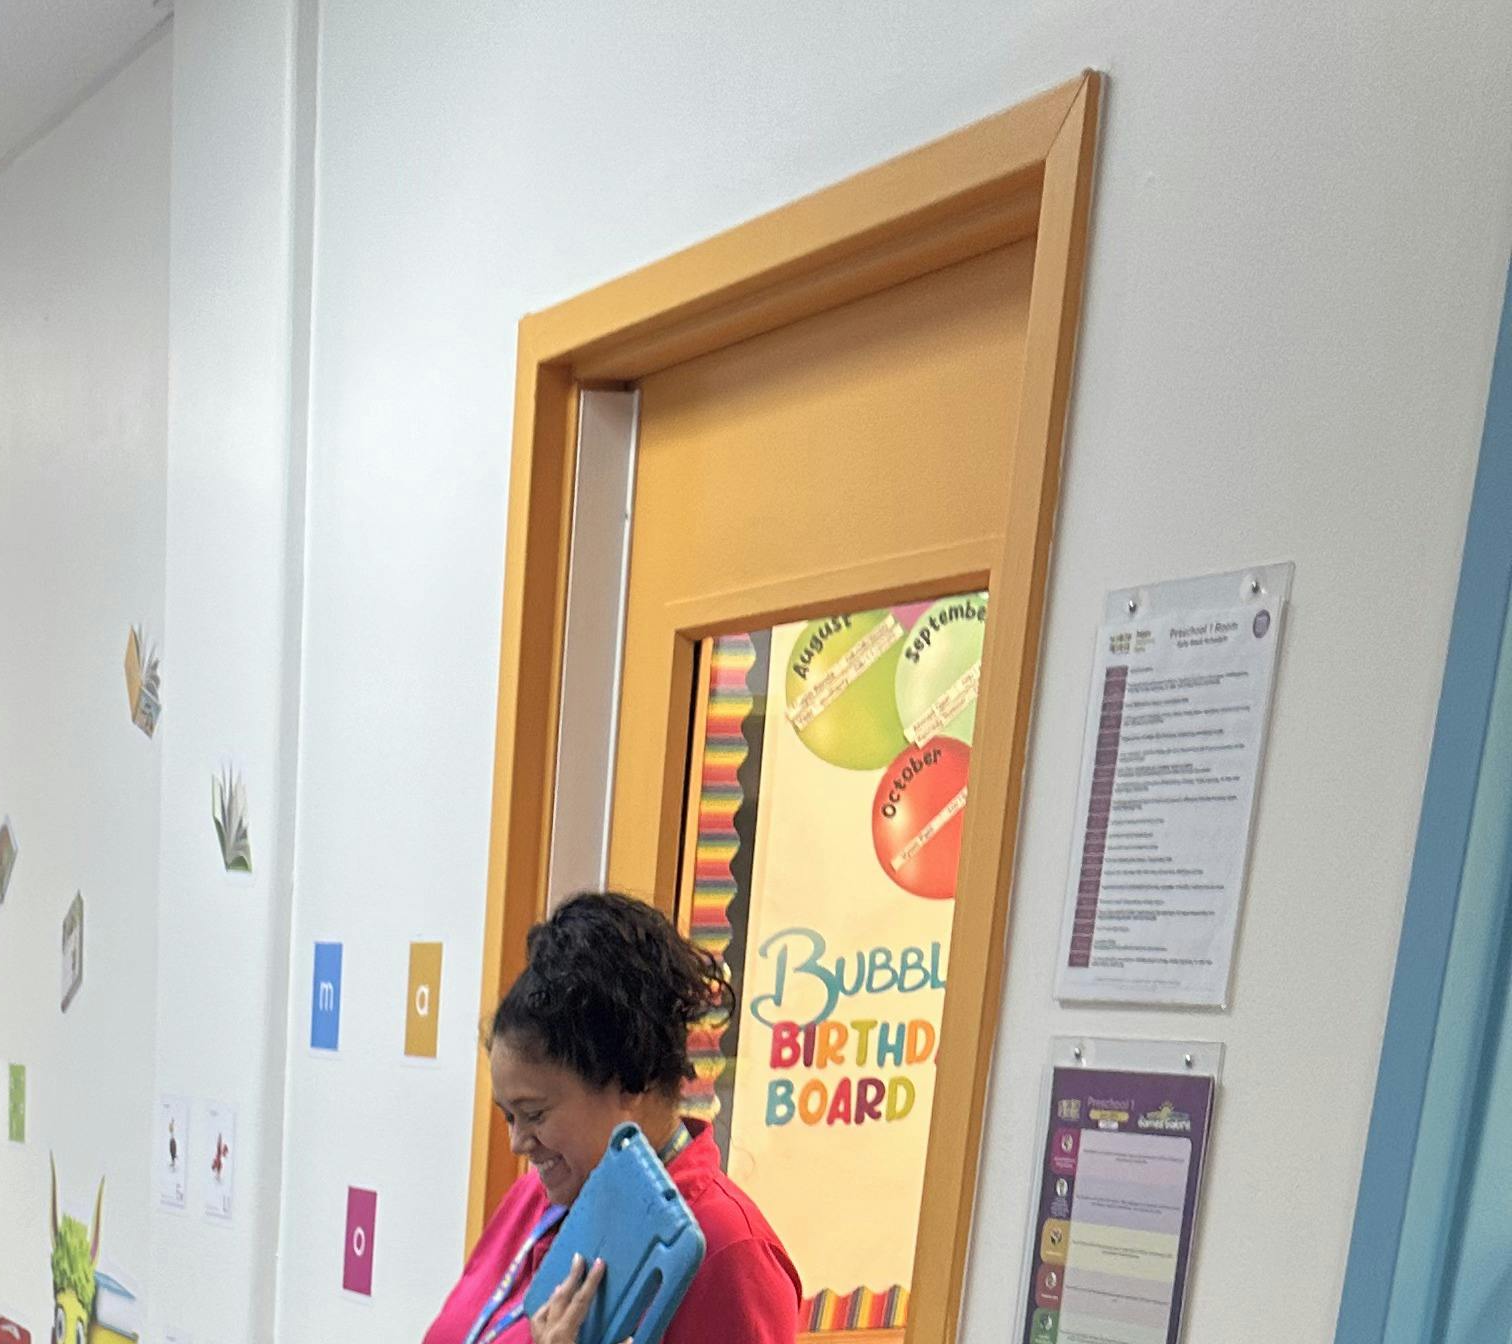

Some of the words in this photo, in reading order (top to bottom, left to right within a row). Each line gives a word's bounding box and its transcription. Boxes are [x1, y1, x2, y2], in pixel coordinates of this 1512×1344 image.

[882, 748, 942, 818] October
[319, 981, 334, 1012] m
[415, 984, 429, 1017] a
[769, 1018, 938, 1070] BIRTHD
[765, 1076, 916, 1127] BOARD
